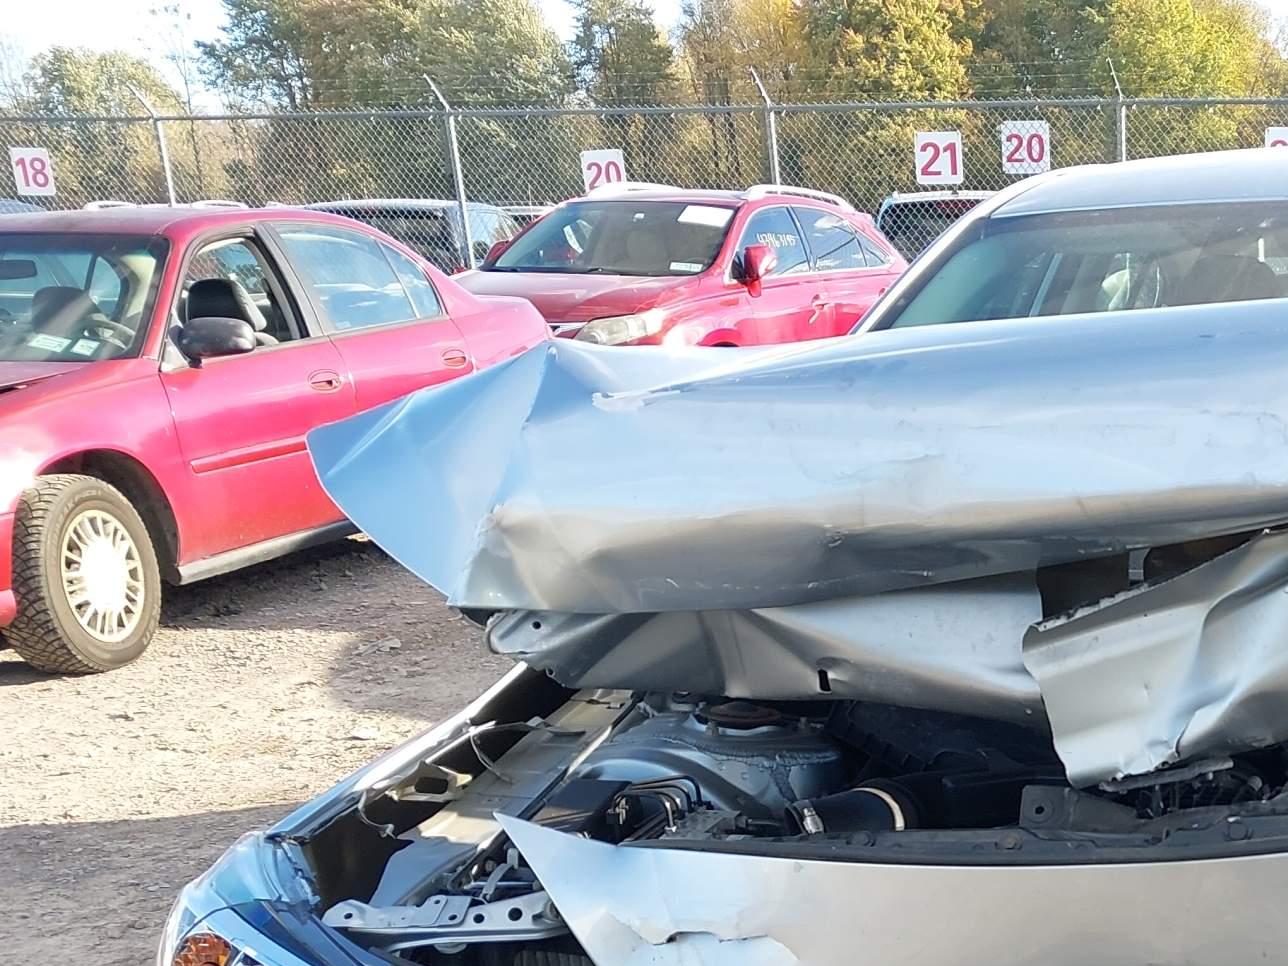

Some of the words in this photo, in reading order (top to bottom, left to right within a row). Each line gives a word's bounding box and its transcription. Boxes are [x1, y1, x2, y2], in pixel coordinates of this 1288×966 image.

[919, 141, 958, 176] 21
[1006, 133, 1045, 163] 20
[15, 157, 49, 188] 18
[586, 161, 622, 190] 20
